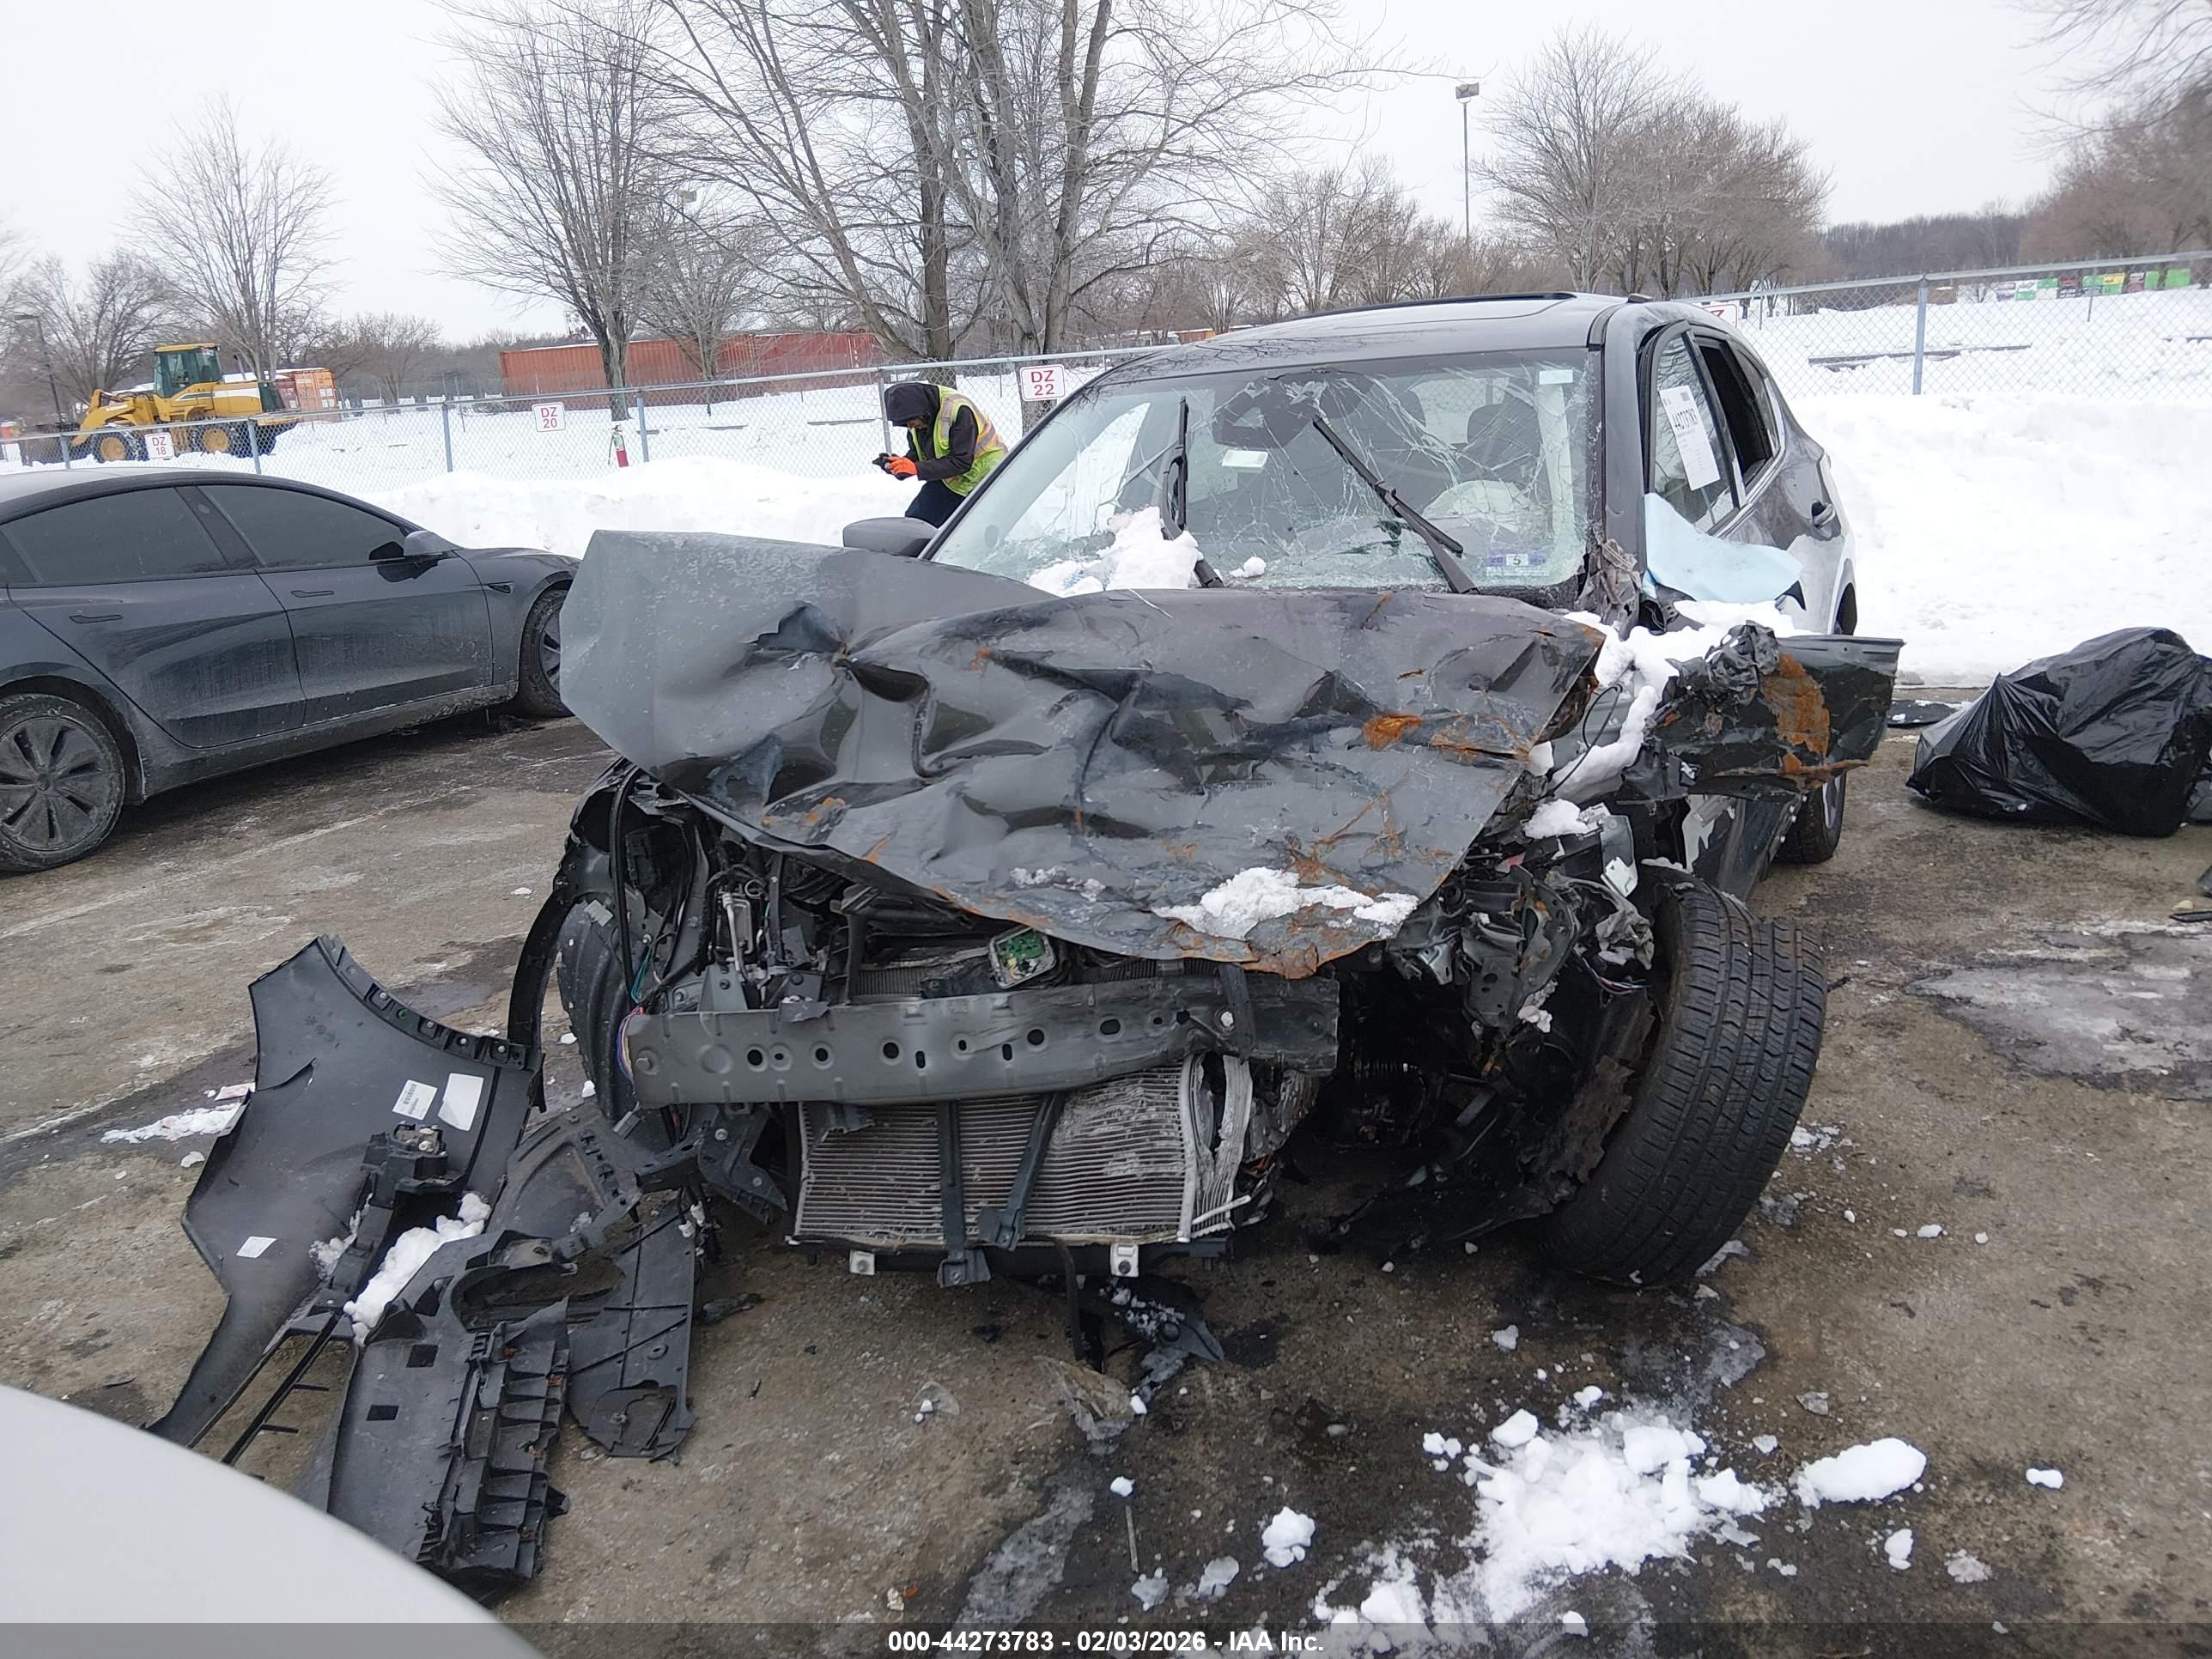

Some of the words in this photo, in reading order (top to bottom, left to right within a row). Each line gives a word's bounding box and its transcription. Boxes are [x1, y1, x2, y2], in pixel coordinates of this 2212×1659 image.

[1030, 369, 1055, 383] DZ
[1034, 383, 1055, 396] 22
[541, 406, 557, 417] DZ
[543, 417, 557, 428] 20
[152, 436, 167, 446] DZ
[156, 447, 167, 455] 18
